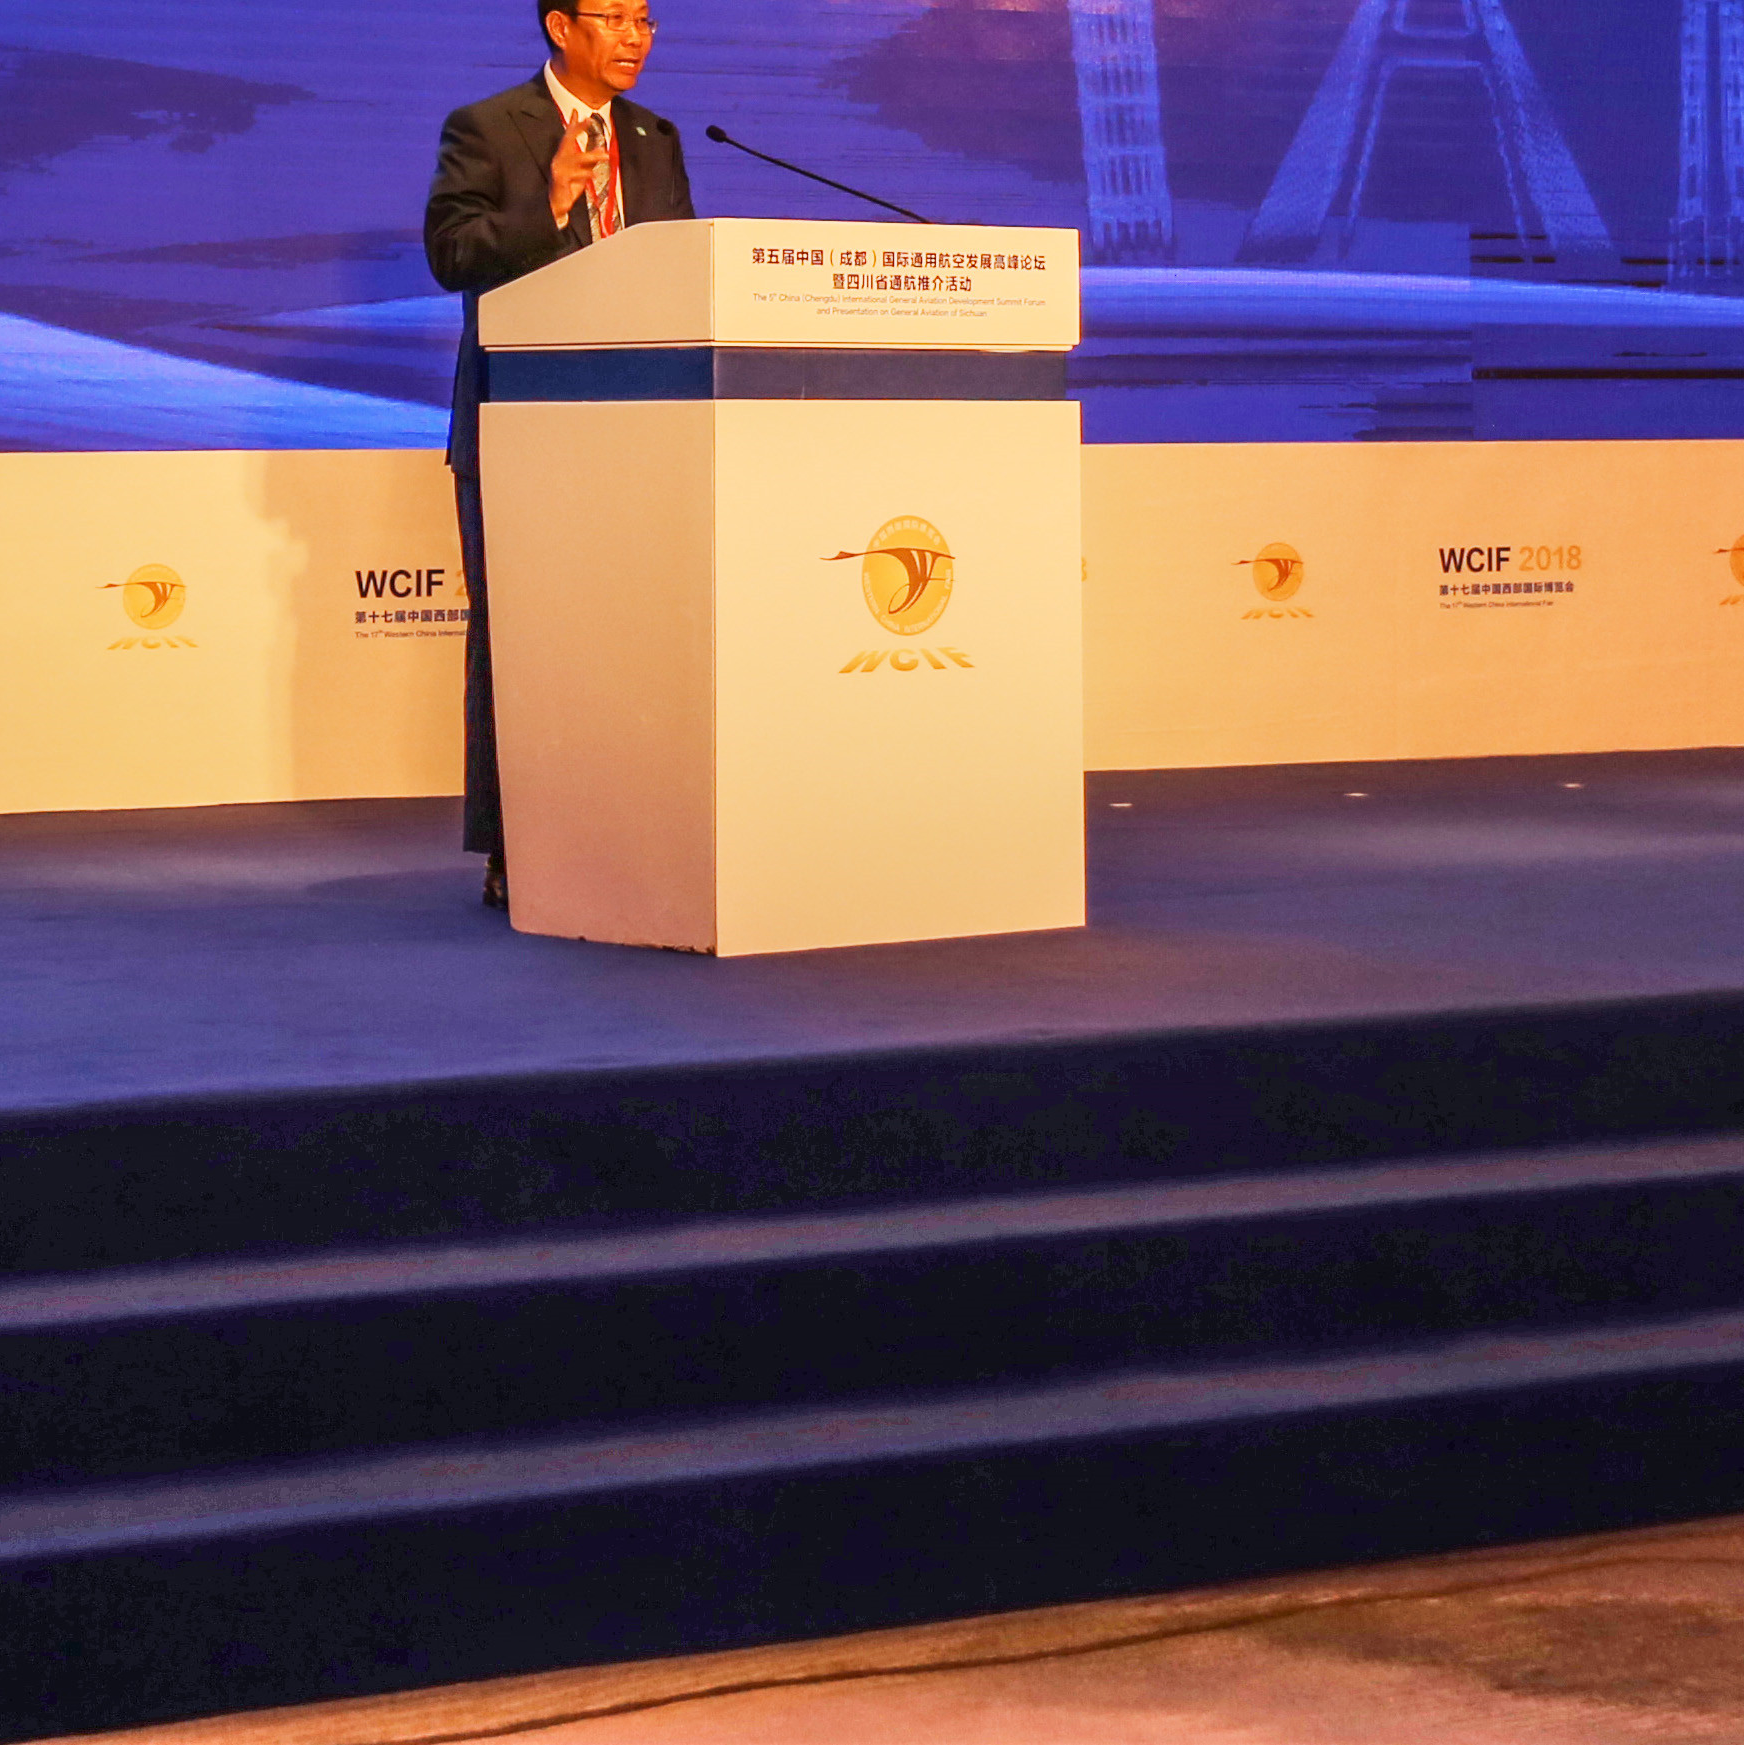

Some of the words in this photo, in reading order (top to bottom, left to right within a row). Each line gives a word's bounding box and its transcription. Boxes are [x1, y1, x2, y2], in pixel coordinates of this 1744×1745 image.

[832, 273, 972, 292] 暨四川省通航推介活动
[1439, 546, 1511, 573] WCIF
[1519, 545, 1582, 572] 2018
[355, 569, 445, 599] WCIF
[838, 646, 976, 673] WCIF
